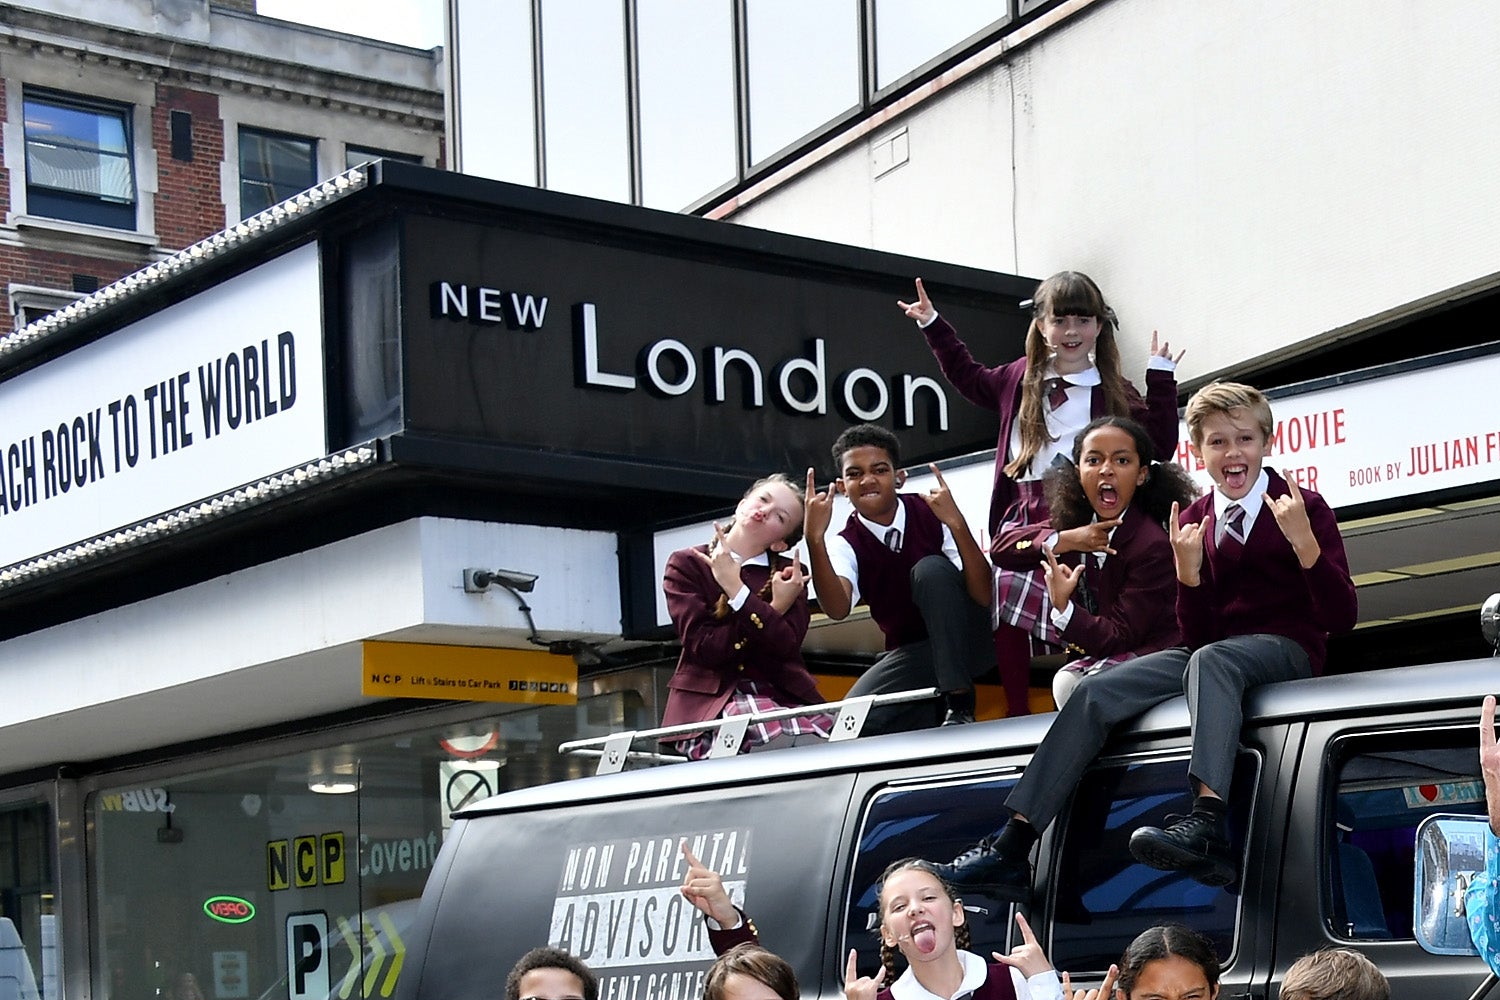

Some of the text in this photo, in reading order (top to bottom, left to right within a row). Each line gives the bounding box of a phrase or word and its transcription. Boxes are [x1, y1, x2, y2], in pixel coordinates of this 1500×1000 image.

[441, 281, 948, 431] NEW London
[0, 330, 297, 517] ACH ROCK TO THE WORLD
[1349, 467, 1382, 488] BOOK
[1386, 462, 1402, 481] BY
[1407, 436, 1479, 478] JULIAN
[411, 676, 425, 685] Lift
[433, 678, 456, 688] Stairs
[458, 679, 466, 688] to
[468, 679, 482, 688] Car
[483, 680, 501, 689] Park
[561, 844, 615, 891] NON
[293, 924, 321, 994] P
